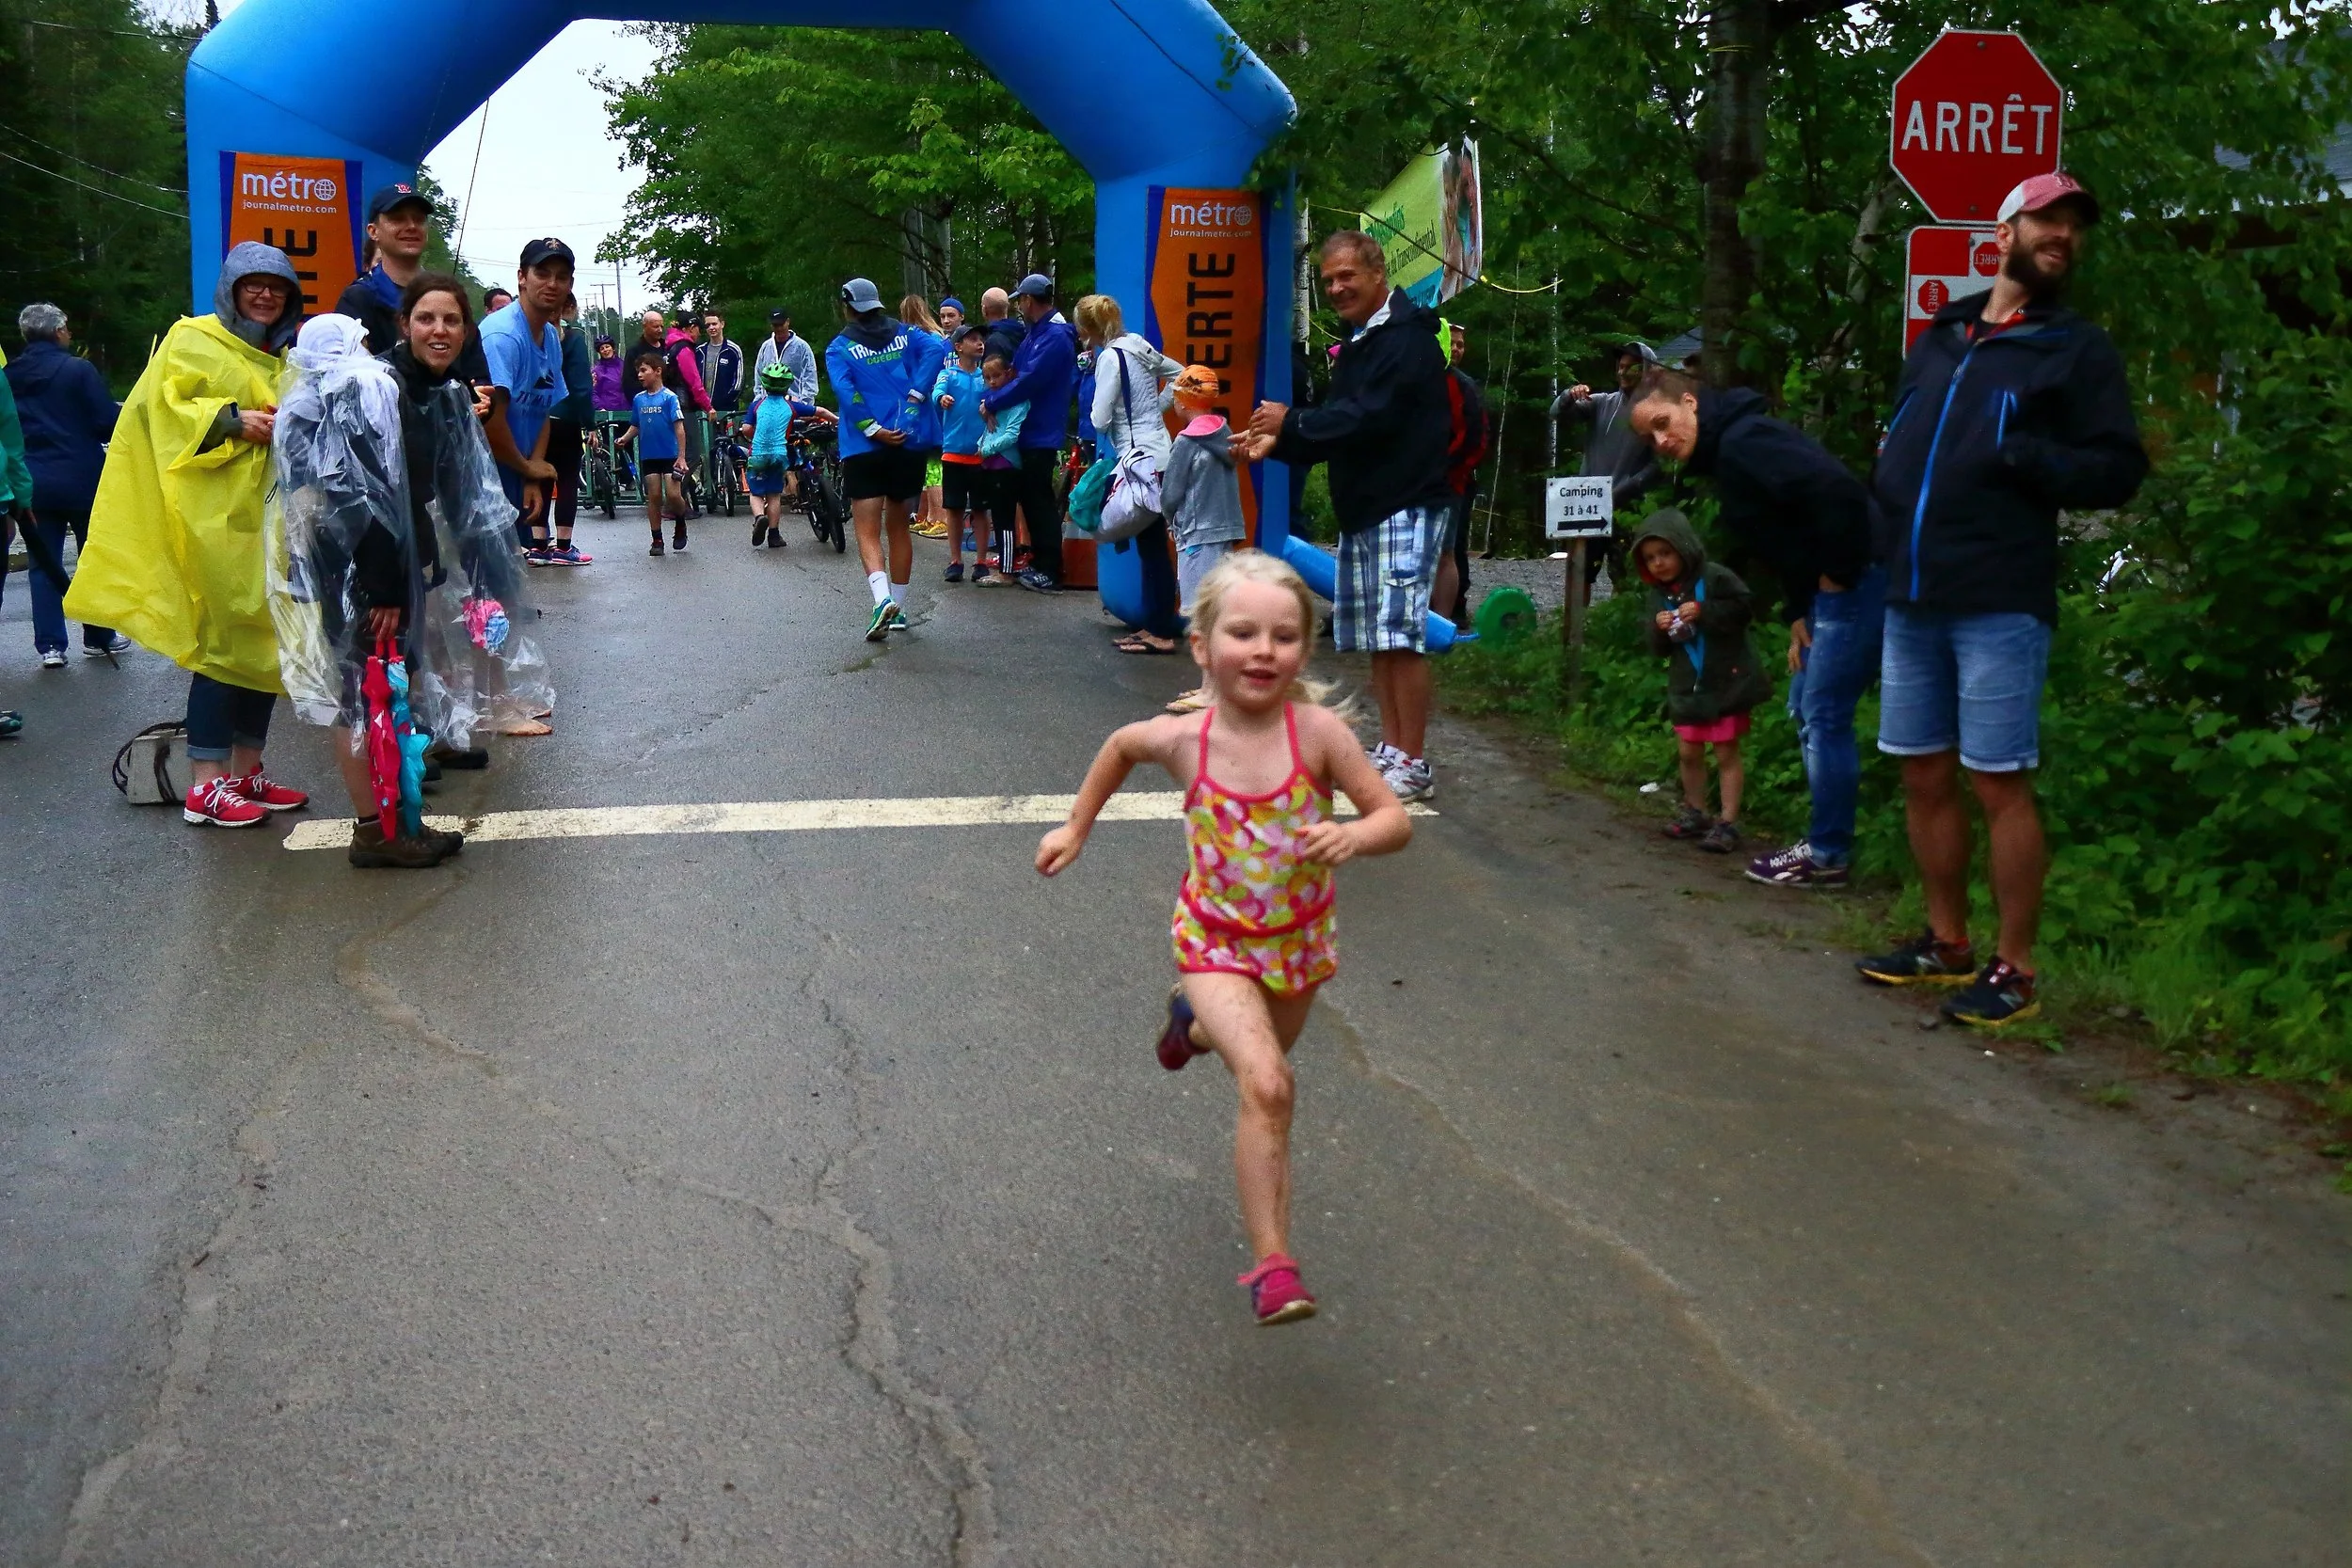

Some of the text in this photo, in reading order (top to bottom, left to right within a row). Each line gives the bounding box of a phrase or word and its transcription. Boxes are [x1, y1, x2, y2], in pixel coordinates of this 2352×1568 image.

[1900, 94, 2053, 155] ARRÊT
[242, 171, 337, 201] métro
[243, 199, 337, 214] journalmetro.com
[1170, 201, 1252, 226] métro
[1170, 228, 1252, 238] journalmetro.com
[1560, 485, 1603, 498] Camping
[1564, 505, 1598, 516] 31 à 41
